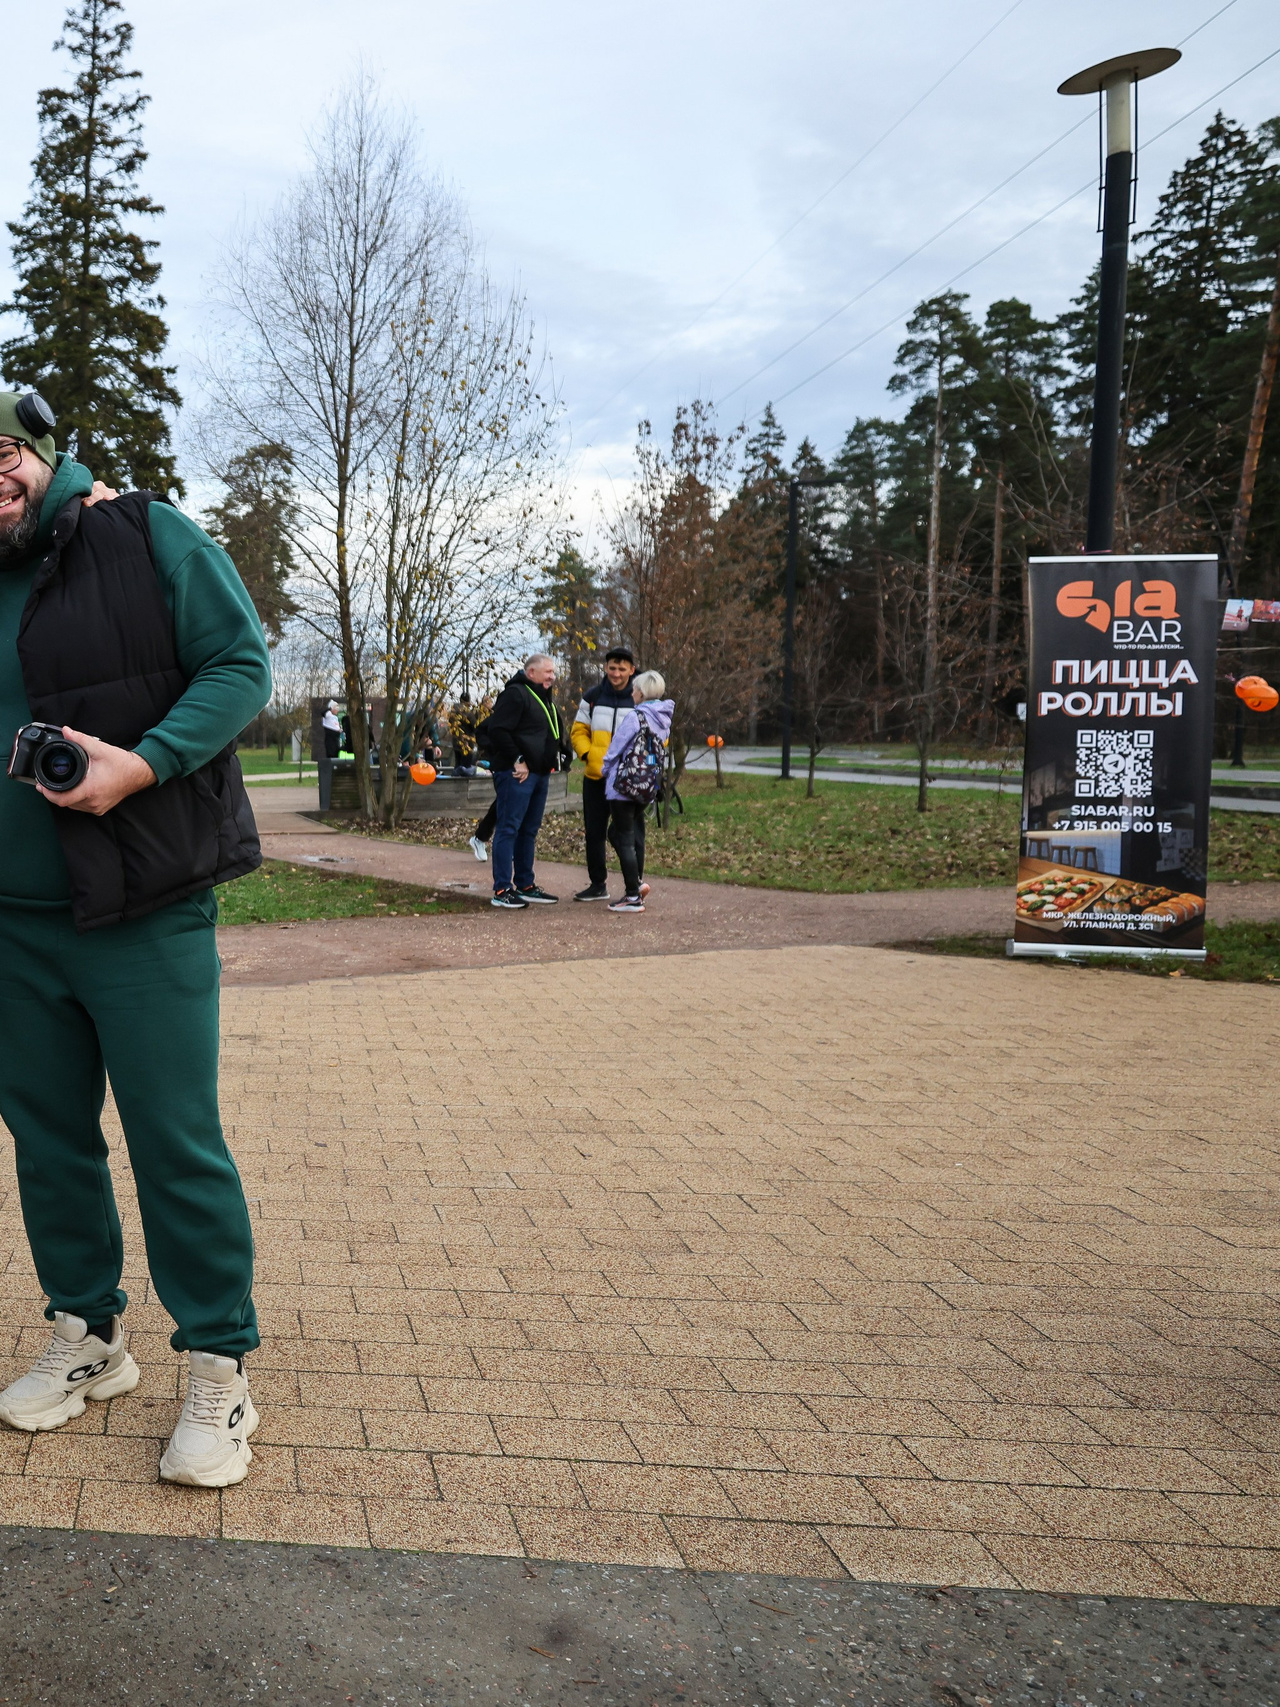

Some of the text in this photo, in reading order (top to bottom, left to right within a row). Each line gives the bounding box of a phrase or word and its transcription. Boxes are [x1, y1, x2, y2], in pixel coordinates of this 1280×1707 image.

[1112, 620, 1182, 643] BAR
[1052, 659, 1199, 690] ПИЦЦА
[1037, 691, 1184, 717] РОЛЛЫ
[1071, 805, 1155, 817] SIABAR.RU
[1052, 820, 1173, 833] +7 915 005 00 15
[1042, 911, 1177, 923] МКР. ЖЕЛЕЗНОДОРОЖНЫЙ,
[1080, 921, 1126, 930] ГЛАВНАЯ
